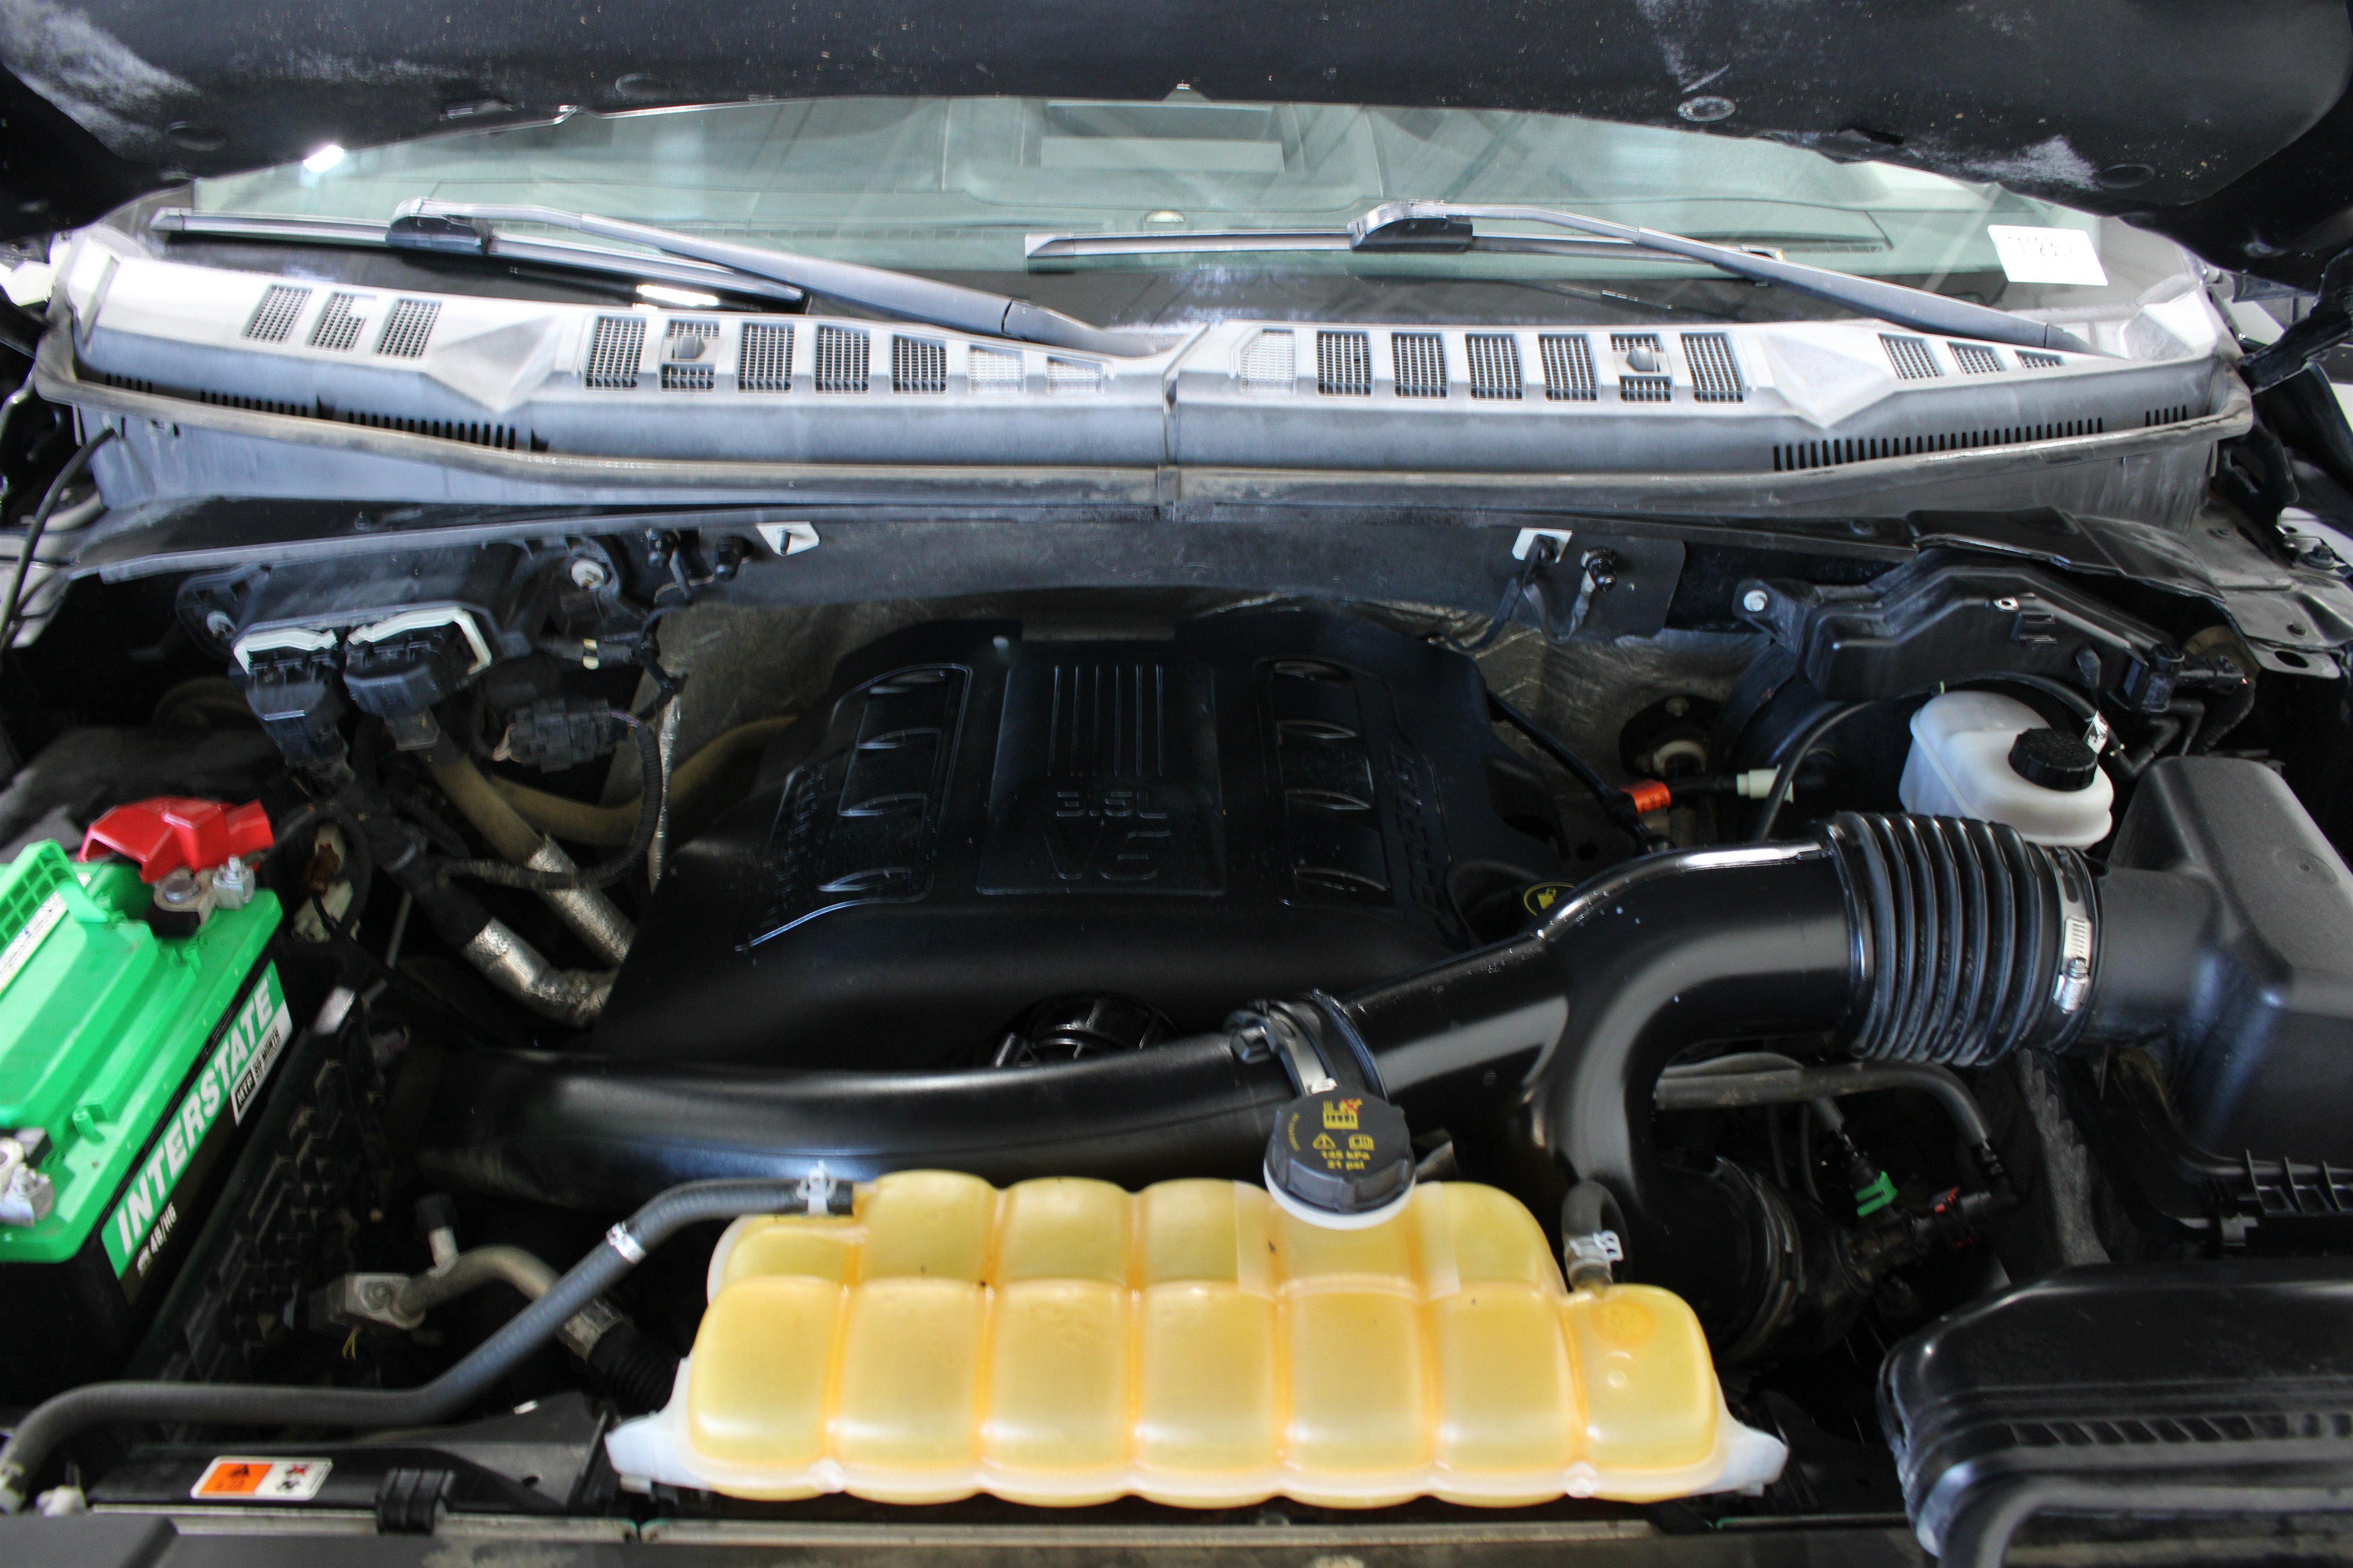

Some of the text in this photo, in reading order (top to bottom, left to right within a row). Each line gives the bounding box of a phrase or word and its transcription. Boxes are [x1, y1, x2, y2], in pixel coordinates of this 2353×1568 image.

[1056, 788, 1168, 819] 3.5L
[1039, 821, 1171, 880] V6
[117, 978, 274, 1256] INTERSTATE
